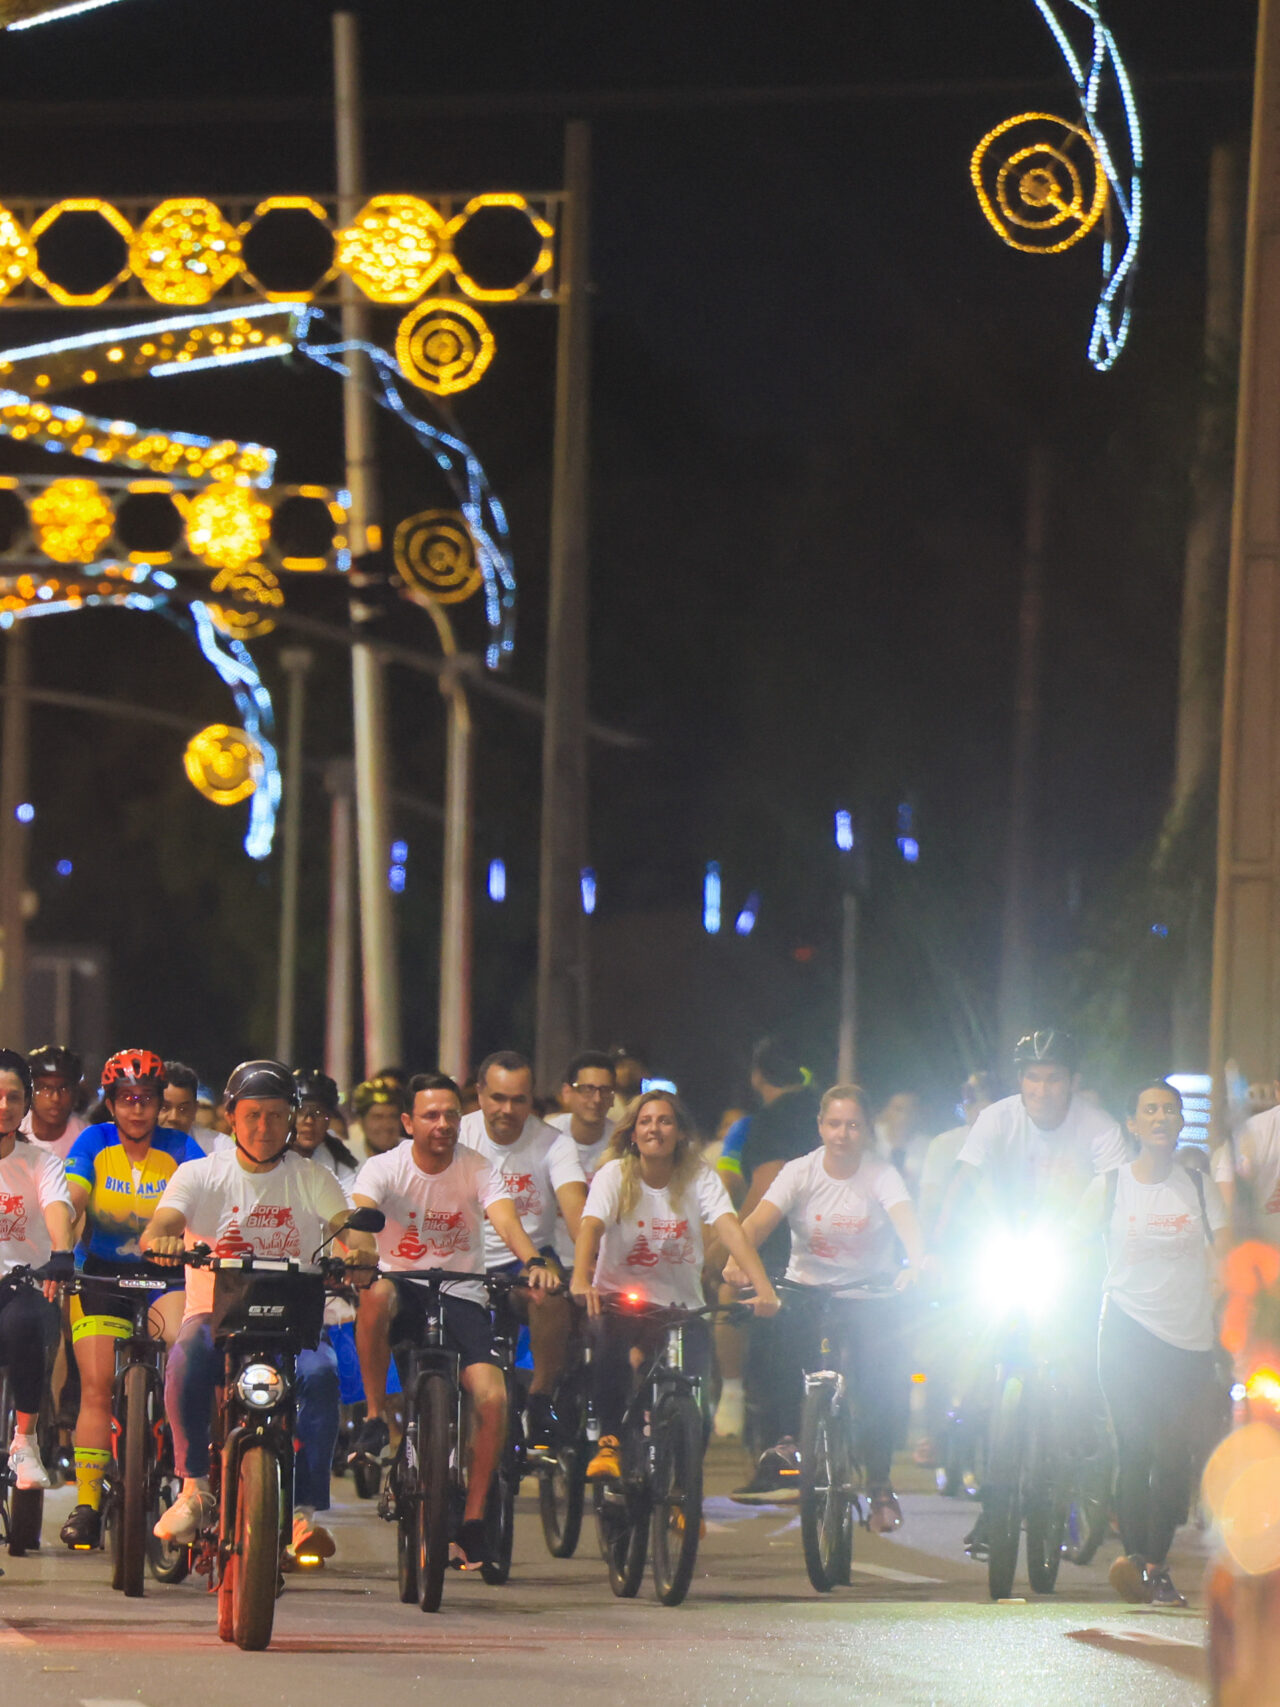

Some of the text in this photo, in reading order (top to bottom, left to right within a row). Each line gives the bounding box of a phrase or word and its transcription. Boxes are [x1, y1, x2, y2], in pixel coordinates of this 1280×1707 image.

[105, 1176, 168, 1195] BIKE ANJO
[250, 1205, 281, 1215] Bora
[425, 1210, 452, 1220] Bora
[246, 1215, 280, 1227] Bike
[422, 1220, 450, 1231] Bike
[248, 1305, 285, 1313] GTS
